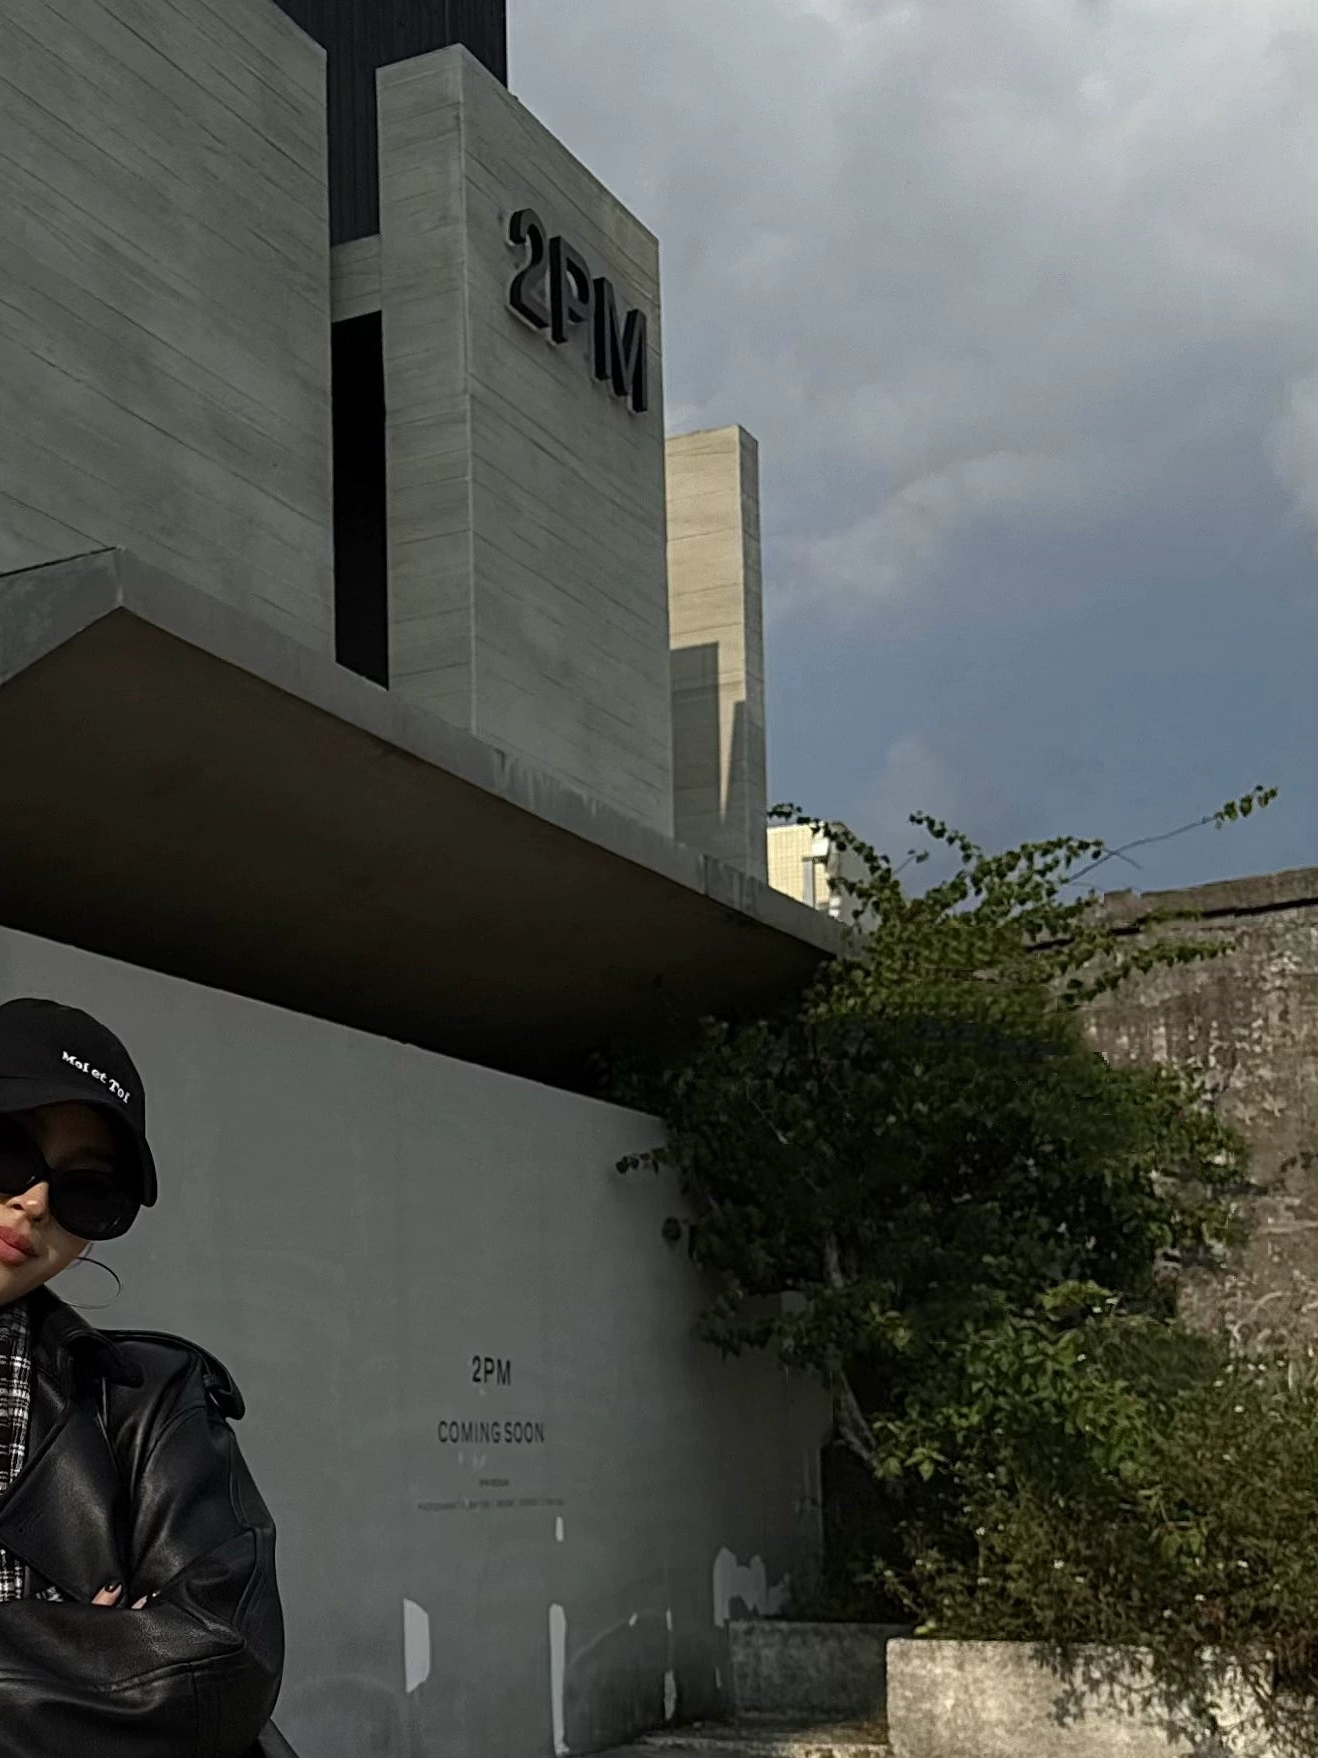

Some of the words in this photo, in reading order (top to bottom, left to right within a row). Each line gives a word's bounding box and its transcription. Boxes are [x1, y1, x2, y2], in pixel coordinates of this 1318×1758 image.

[506, 207, 648, 414] 2PM
[91, 1069, 107, 1084] et
[472, 1355, 512, 1386] 2PM
[437, 1420, 501, 1444] COMING
[504, 1421, 546, 1444] SOON
